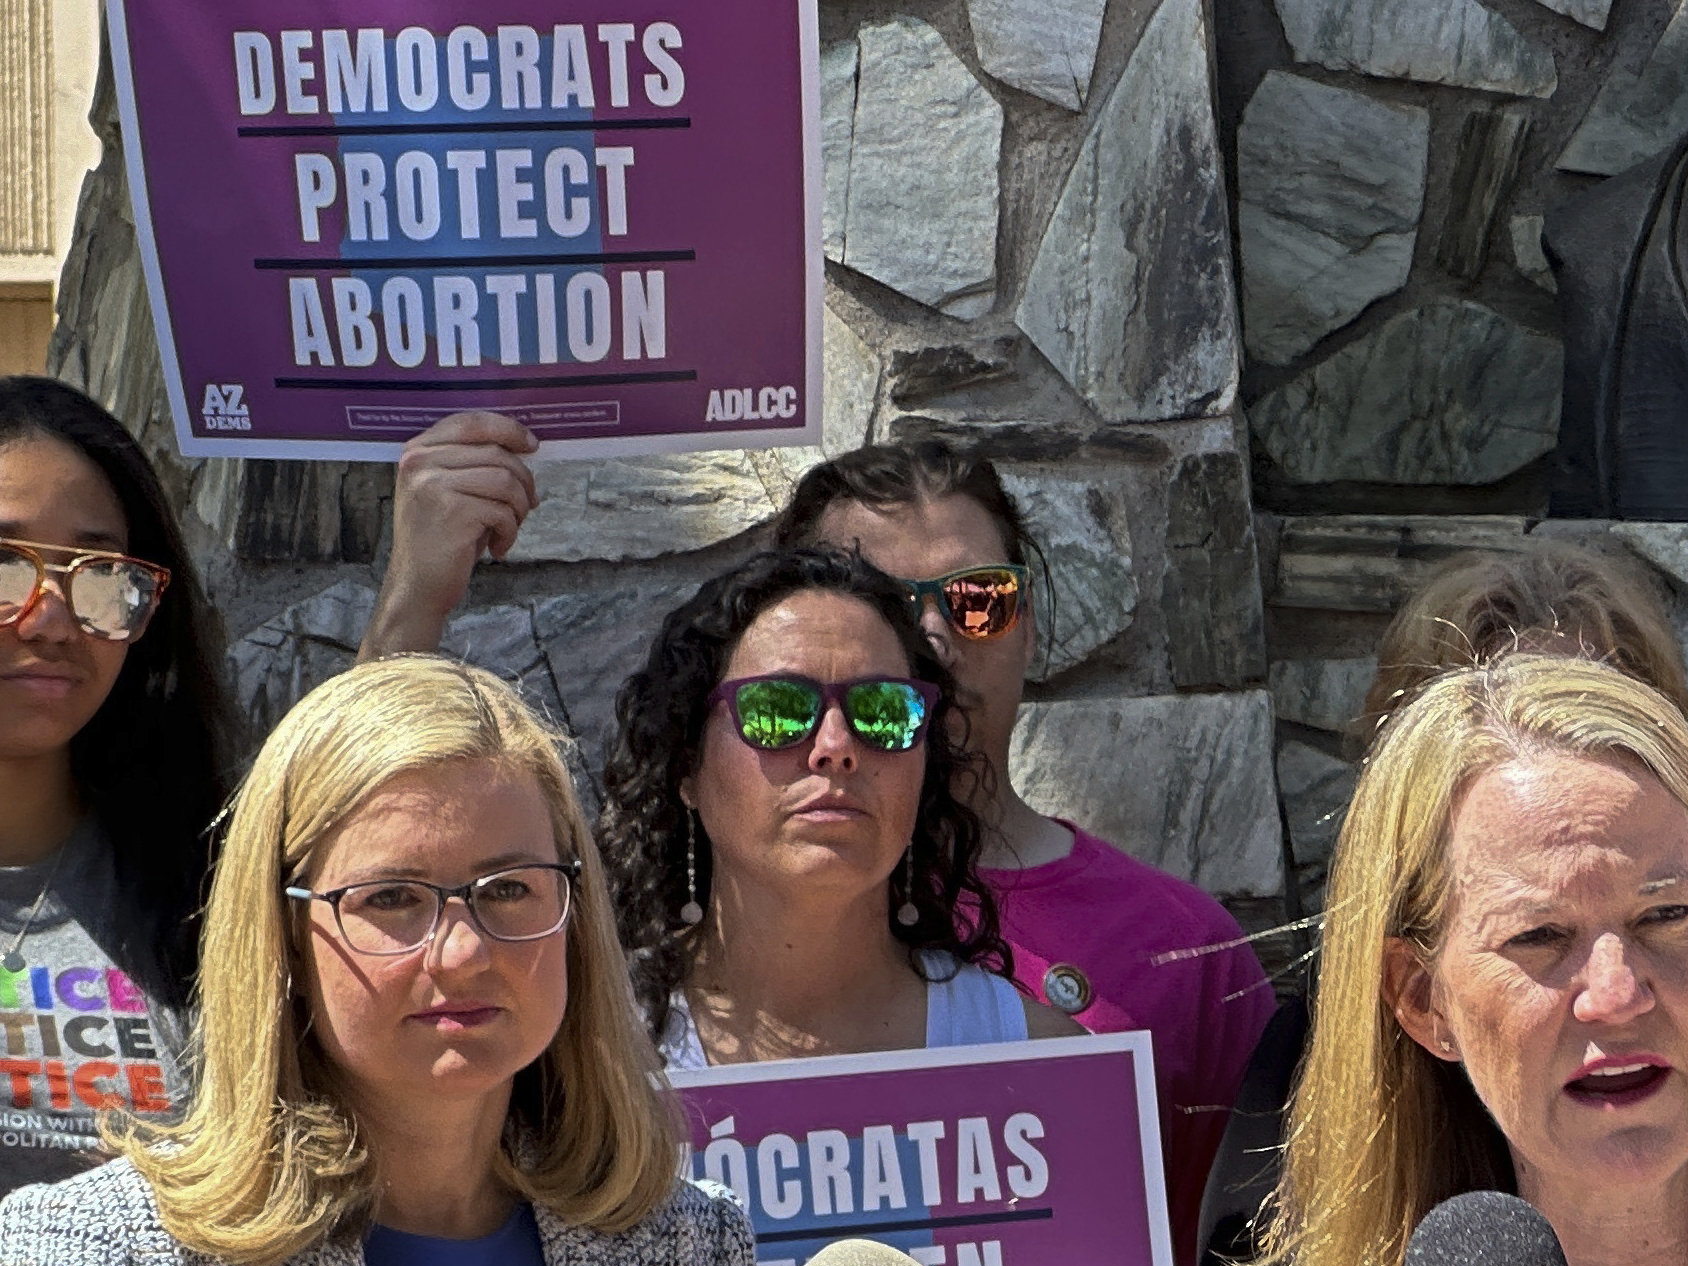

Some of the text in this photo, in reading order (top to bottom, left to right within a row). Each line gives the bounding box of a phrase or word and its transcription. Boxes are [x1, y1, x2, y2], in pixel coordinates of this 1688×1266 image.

[233, 21, 686, 116] DEMOCRATS
[295, 146, 635, 242] PROTECT
[288, 269, 667, 368] ABORTION
[202, 384, 249, 415] AZ
[204, 416, 252, 430] DEMS
[704, 385, 798, 423] ADLCC
